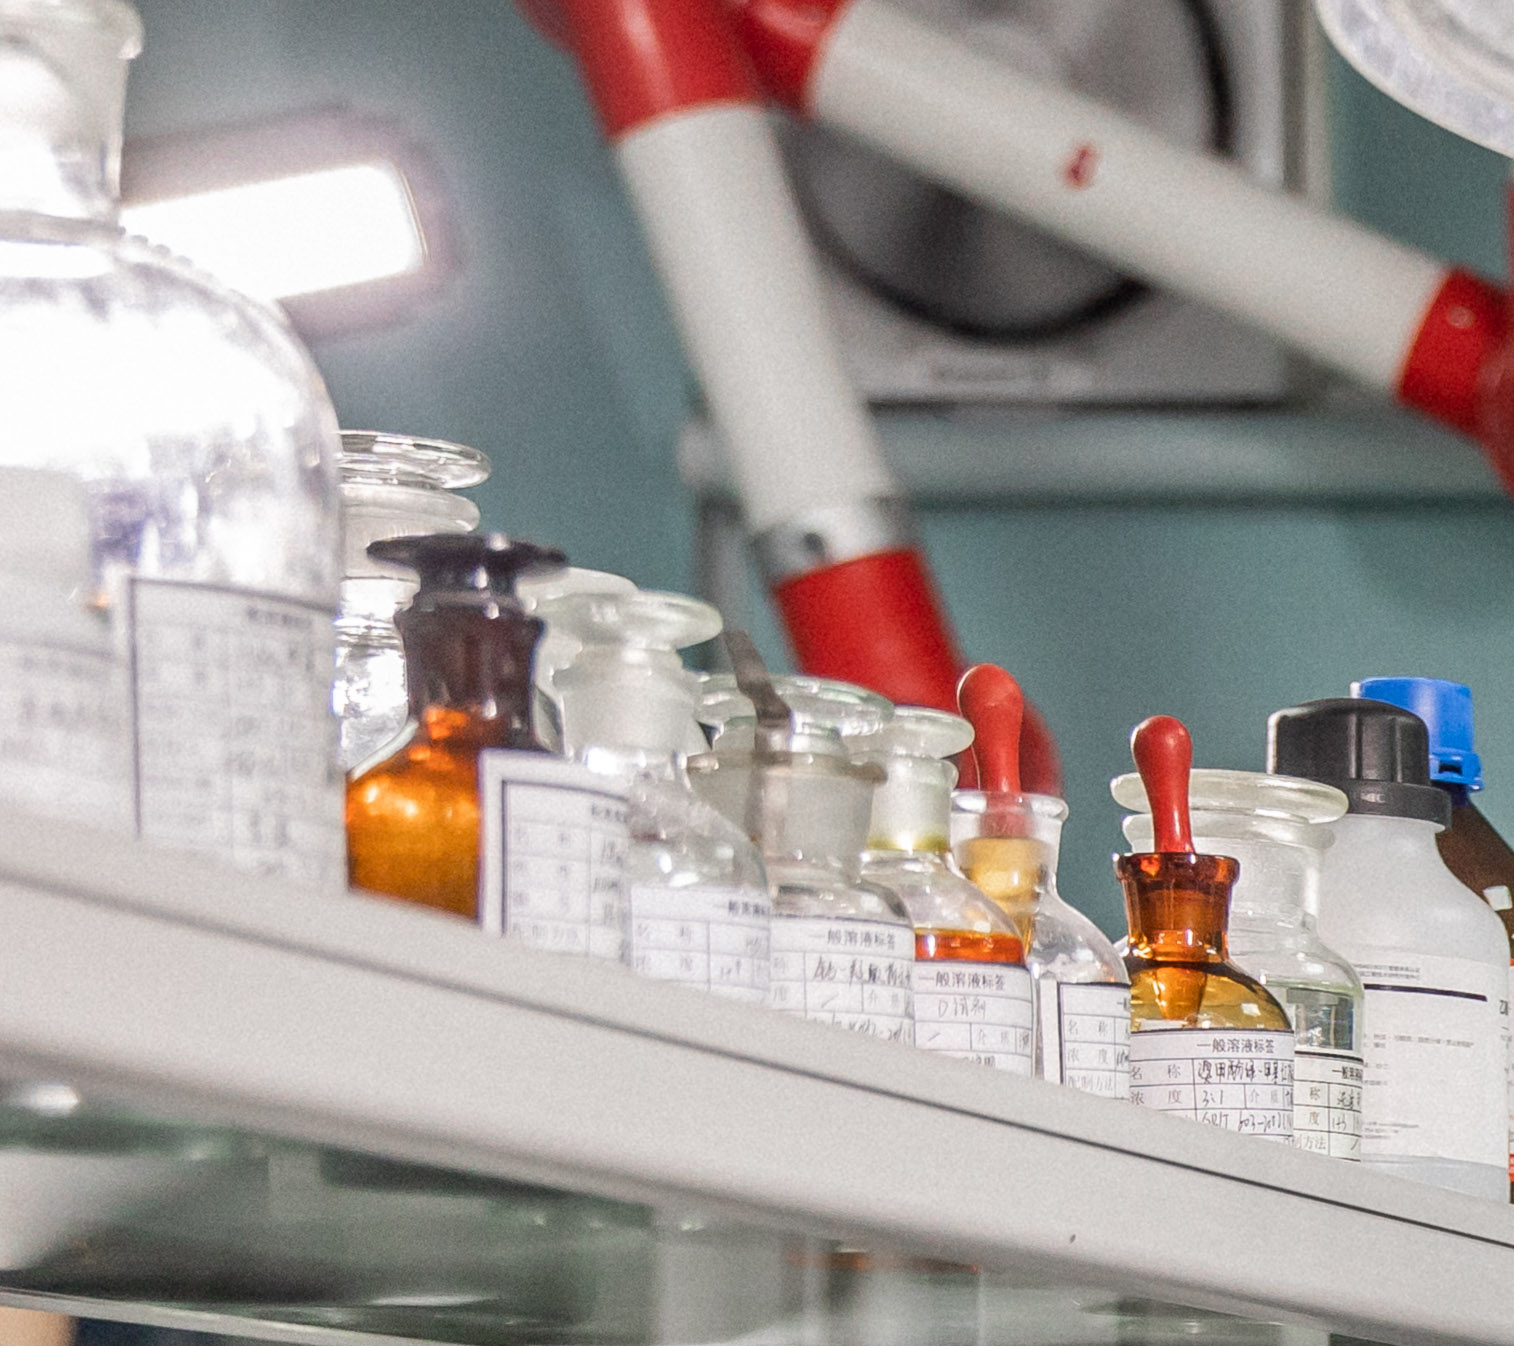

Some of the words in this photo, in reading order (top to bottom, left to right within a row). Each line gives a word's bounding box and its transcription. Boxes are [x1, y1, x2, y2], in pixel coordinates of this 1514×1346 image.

[918, 969, 1005, 992] 一般溶液标签
[1196, 1037, 1275, 1056] 一般溶液标签
